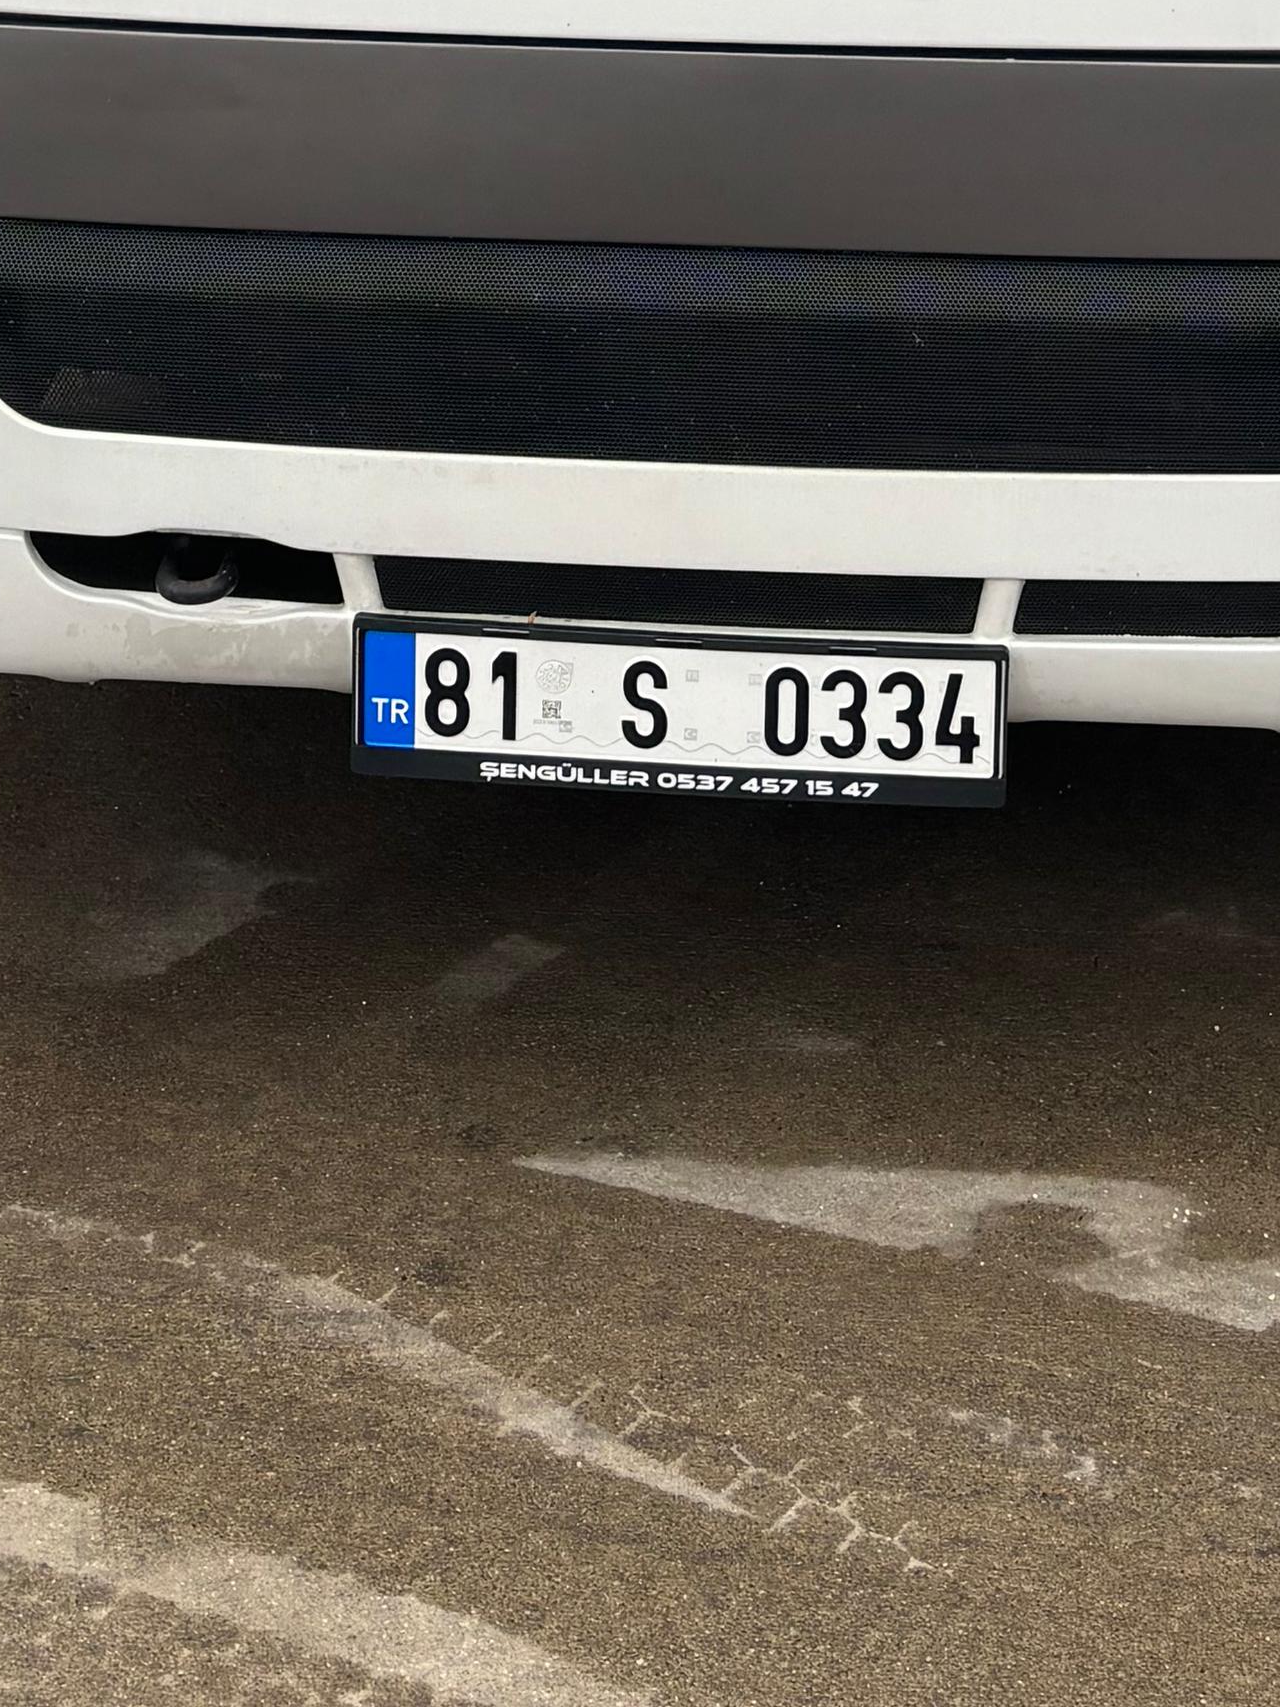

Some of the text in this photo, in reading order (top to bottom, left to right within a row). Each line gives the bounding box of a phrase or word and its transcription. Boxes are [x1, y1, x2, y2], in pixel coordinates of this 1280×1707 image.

[371, 648, 981, 764] TR 81 S 0334
[479, 760, 880, 799] ŞENGÜLLER 0537 457 15 47
